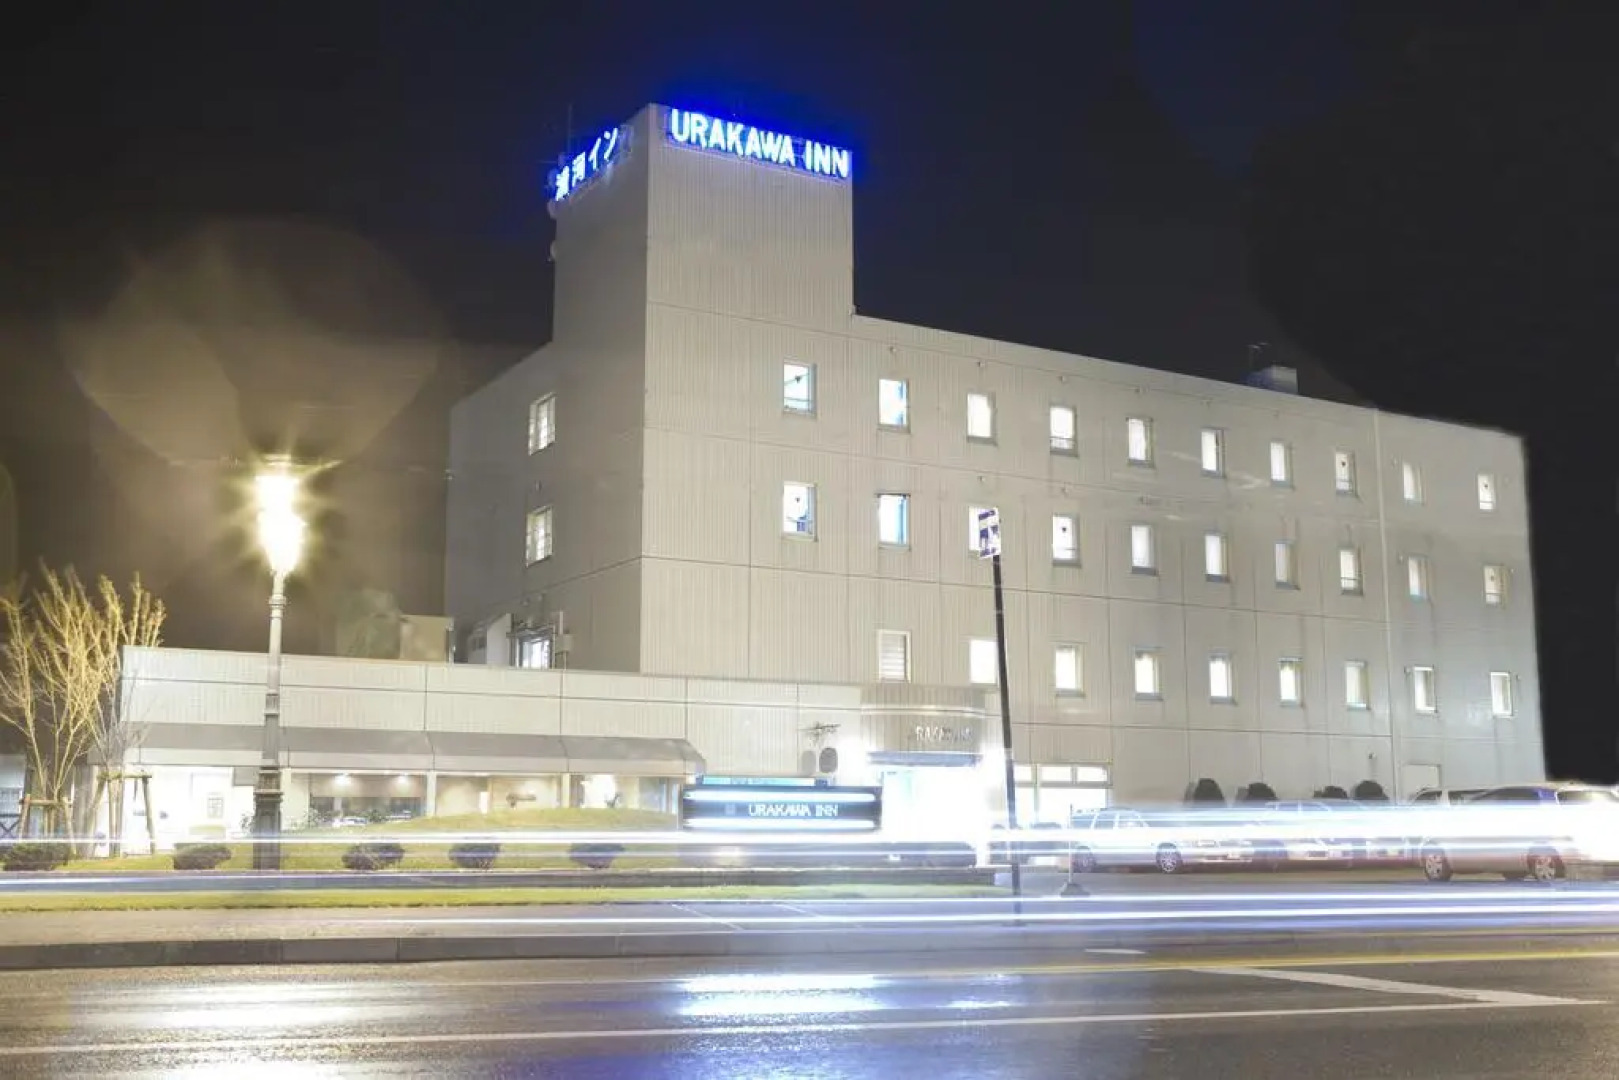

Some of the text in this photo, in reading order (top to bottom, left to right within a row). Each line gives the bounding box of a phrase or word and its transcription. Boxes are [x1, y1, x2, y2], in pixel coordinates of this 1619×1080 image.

[671, 108, 850, 178] URAKAWA INN
[748, 803, 839, 817] URAKAWA INN
